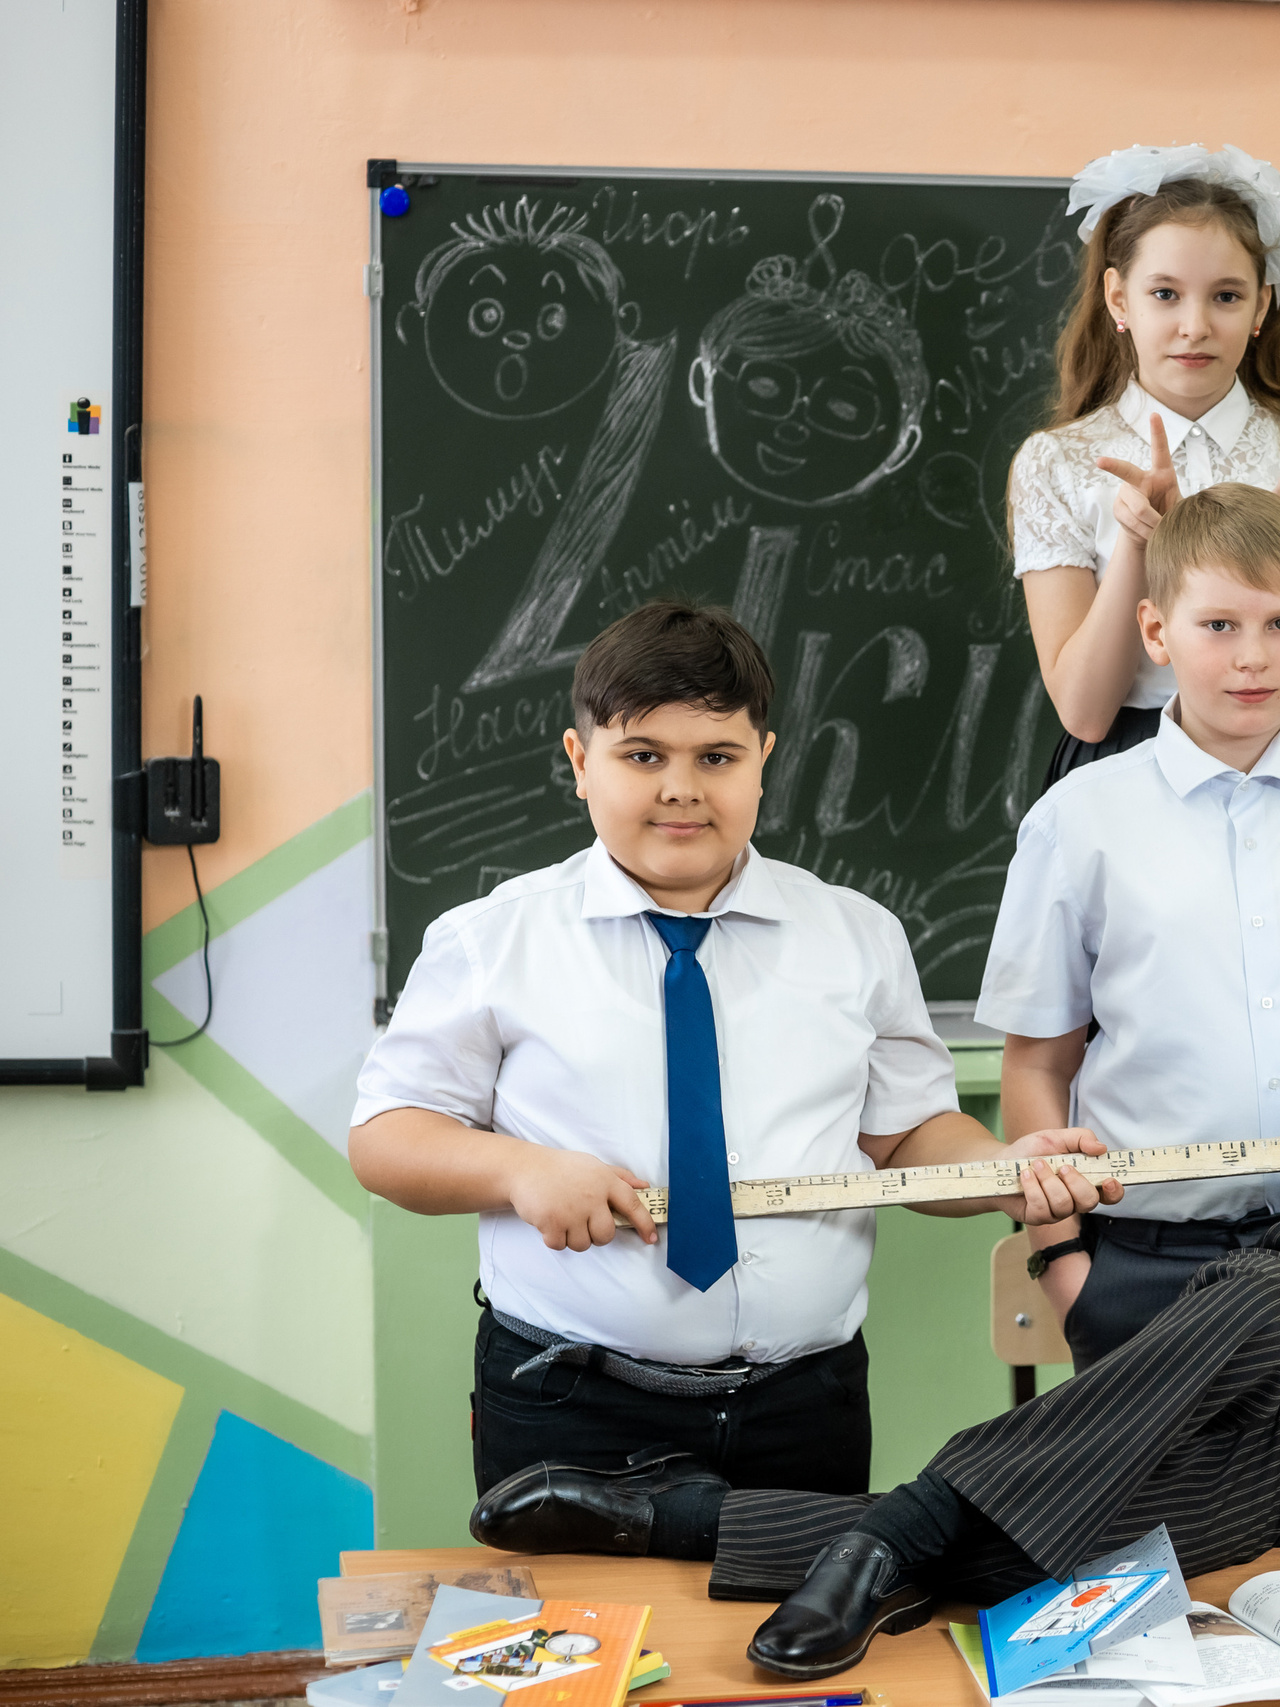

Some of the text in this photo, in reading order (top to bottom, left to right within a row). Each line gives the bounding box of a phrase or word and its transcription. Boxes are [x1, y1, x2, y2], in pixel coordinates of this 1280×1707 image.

[593, 185, 750, 280] Игорь
[879, 197, 1075, 330] фев
[384, 443, 569, 602] Тимур
[805, 519, 954, 599] Стас
[413, 684, 580, 780] Наст
